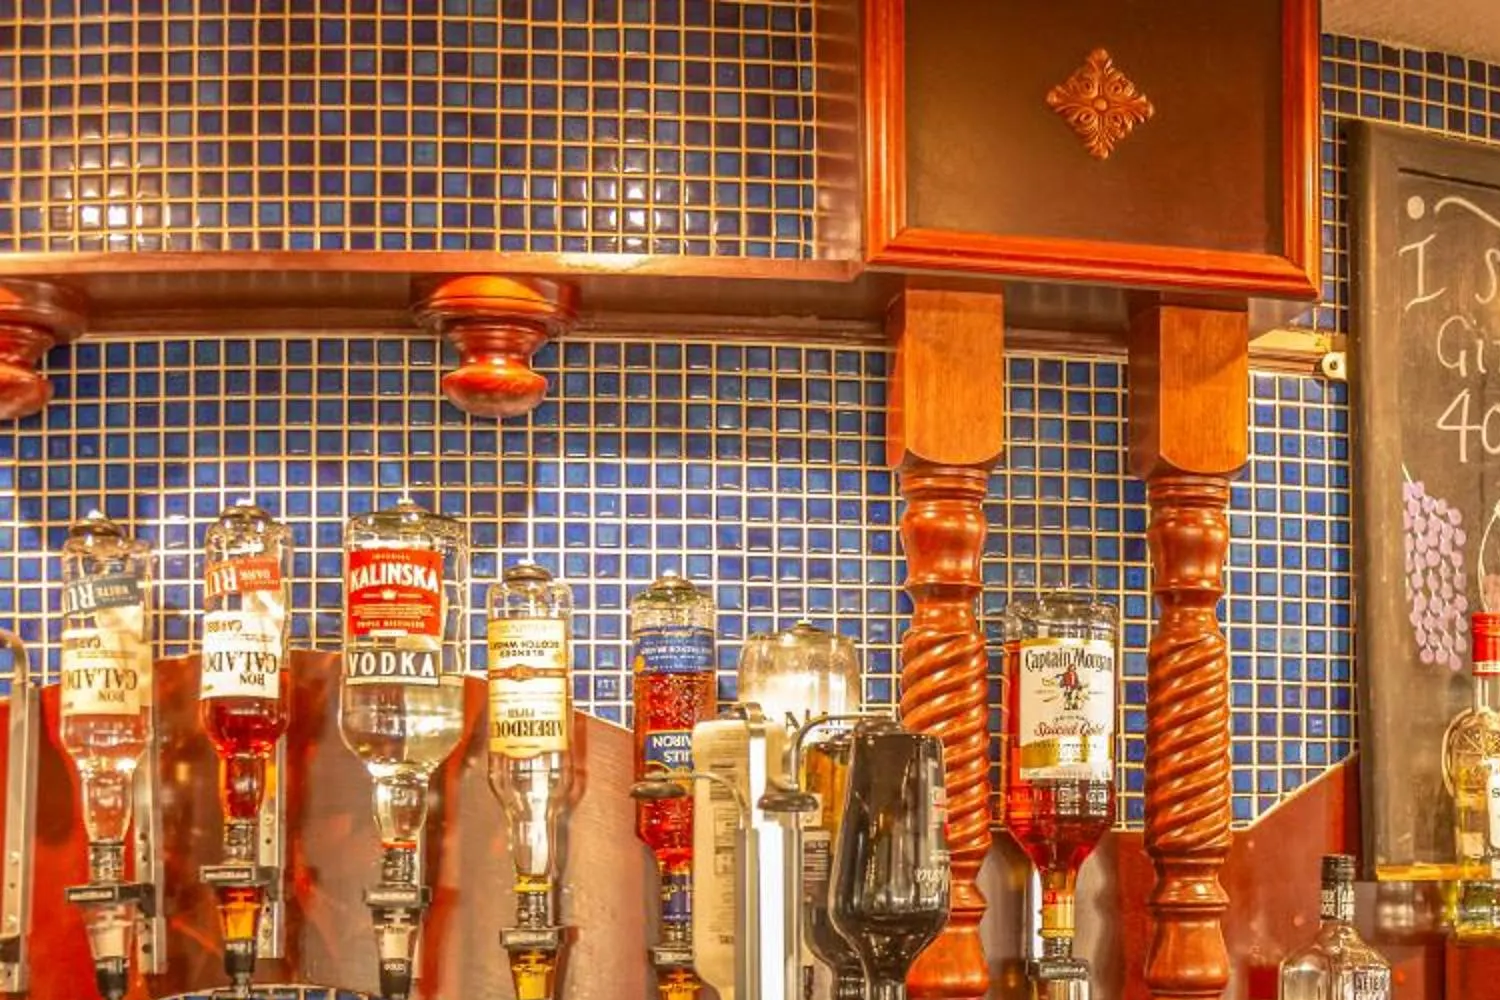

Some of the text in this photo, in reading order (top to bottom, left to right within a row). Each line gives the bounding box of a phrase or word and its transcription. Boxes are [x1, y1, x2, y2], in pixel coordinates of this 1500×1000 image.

[1400, 233, 1449, 312] I
[349, 561, 439, 593] KALINSKA
[347, 650, 436, 677] VODKA
[1025, 647, 1113, 673] Captain Morgan
[239, 673, 266, 686] RON
[97, 690, 125, 704] RON
